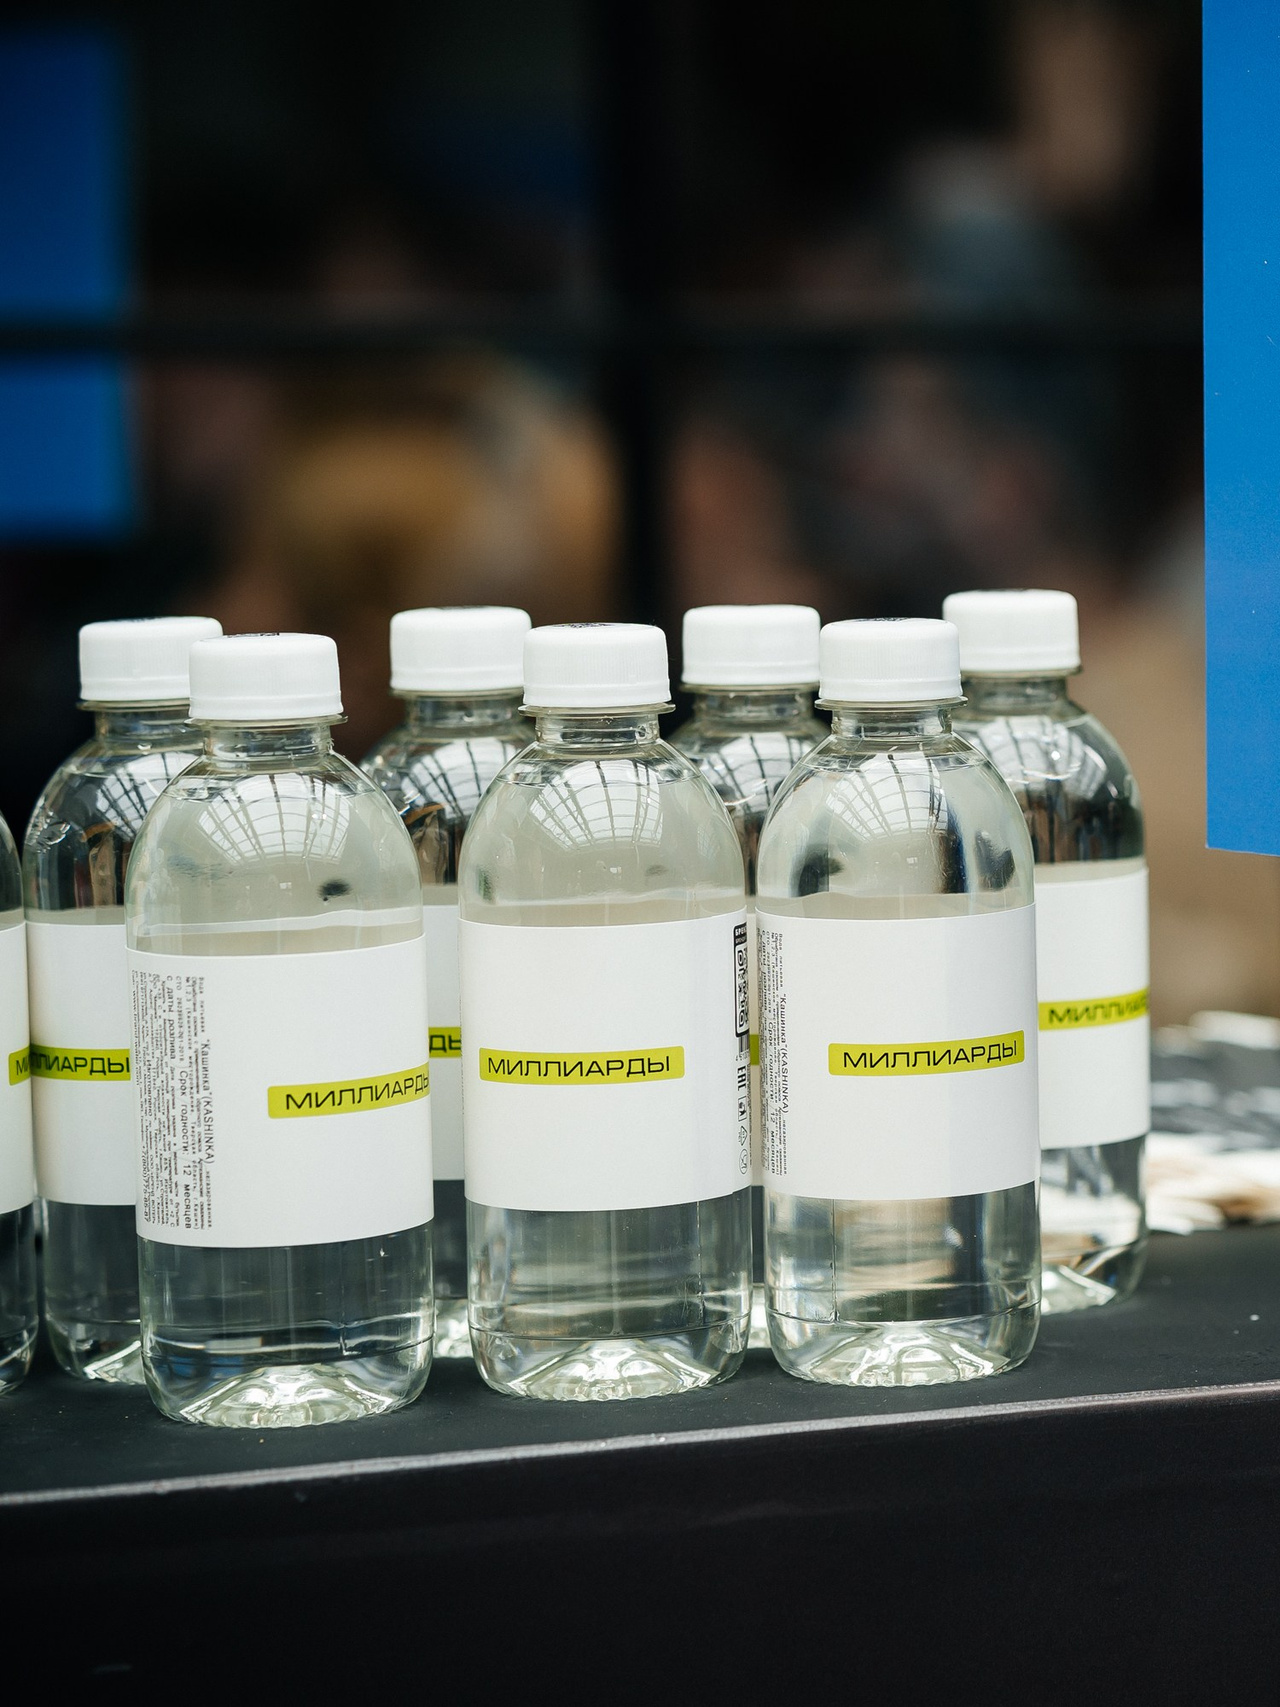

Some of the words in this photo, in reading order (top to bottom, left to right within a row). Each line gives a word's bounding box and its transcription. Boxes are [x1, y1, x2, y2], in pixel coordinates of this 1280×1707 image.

[488, 1056, 670, 1078] МИЛЛИАРДЫ
[843, 1040, 1017, 1069] МИЛЛИАРДЫ
[179, 1070, 189, 1096] Срок
[184, 1164, 192, 1176] 12
[183, 1184, 192, 1229] месяцев
